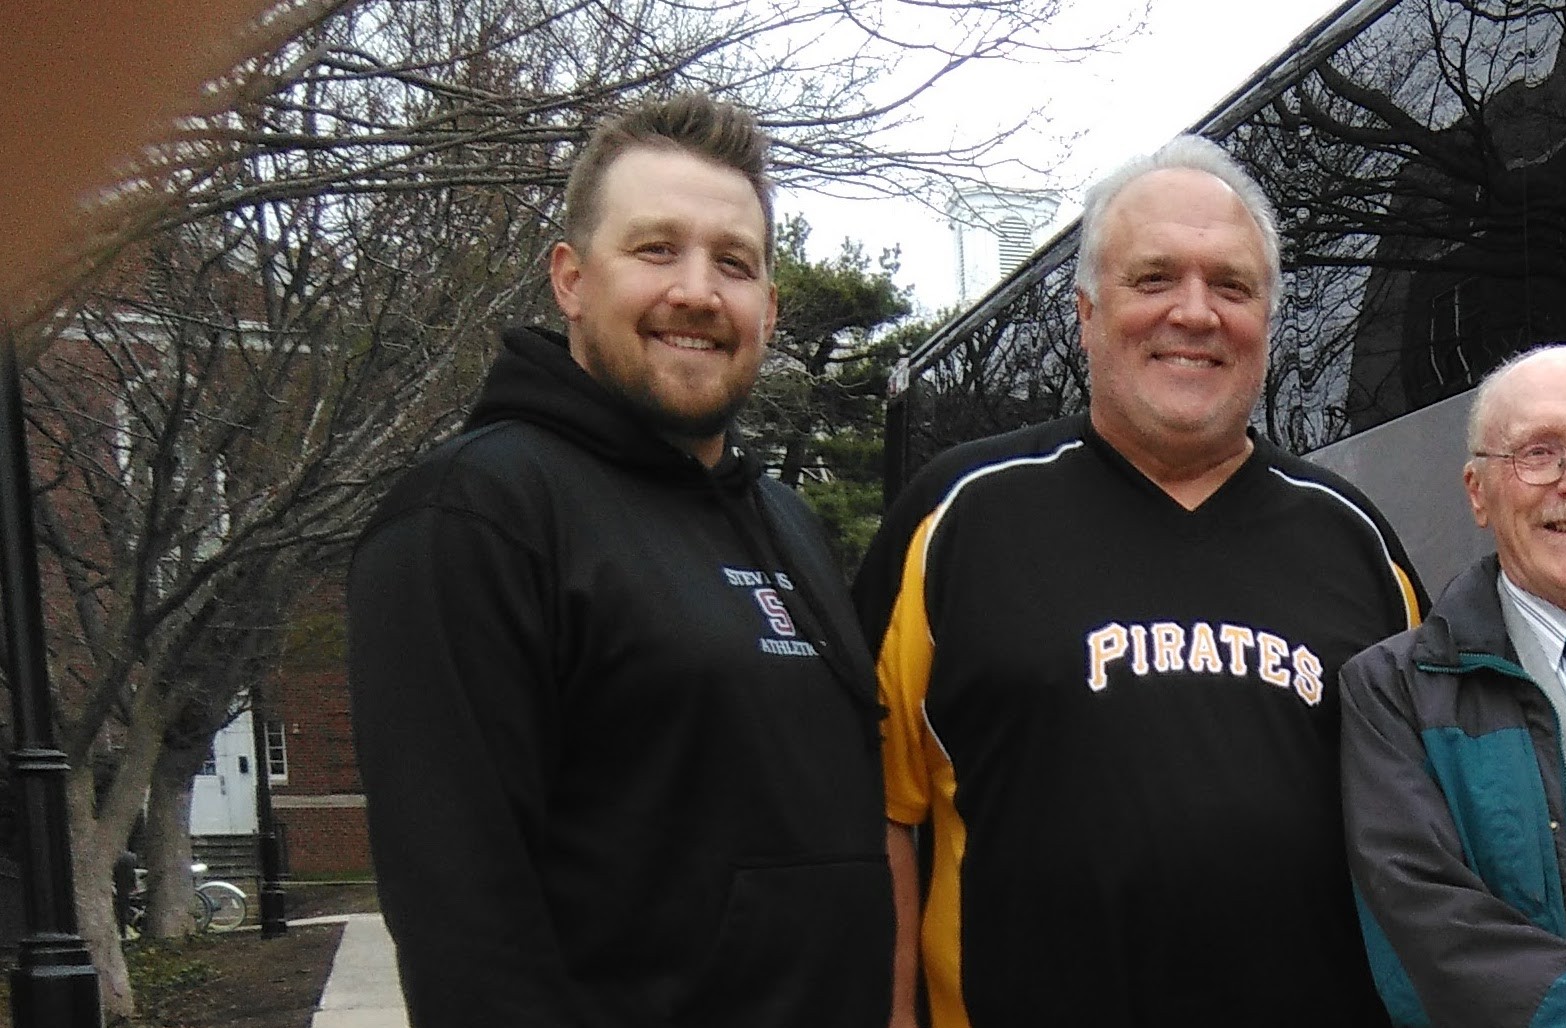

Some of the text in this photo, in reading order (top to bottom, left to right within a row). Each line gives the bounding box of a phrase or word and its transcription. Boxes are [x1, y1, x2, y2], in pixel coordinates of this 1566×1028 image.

[723, 567, 794, 591] STEVS
[755, 588, 797, 636] S
[1088, 622, 1323, 706] PIRATES
